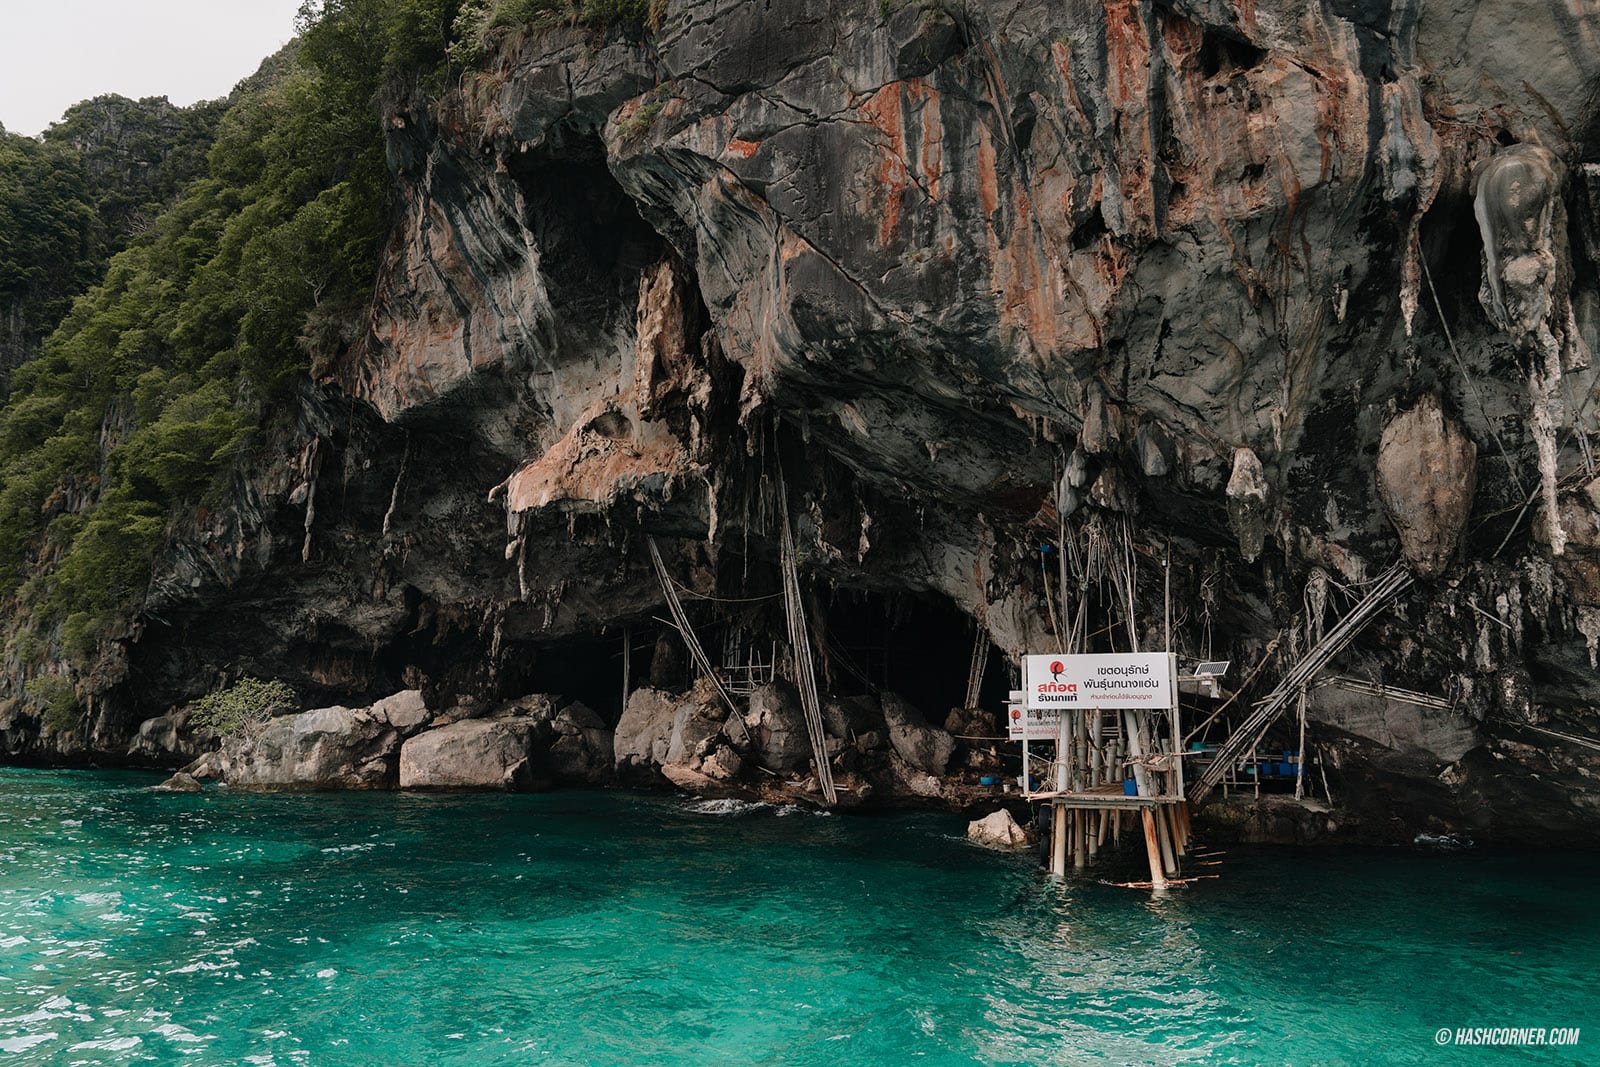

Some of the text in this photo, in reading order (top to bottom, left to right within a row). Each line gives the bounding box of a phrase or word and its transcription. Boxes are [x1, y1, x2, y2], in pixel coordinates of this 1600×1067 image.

[1097, 664, 1149, 677] เขตอนุรักษ์
[1084, 678, 1159, 691] พันธุ์นกนางแอ่น
[1038, 693, 1078, 702] รังนกแท้
